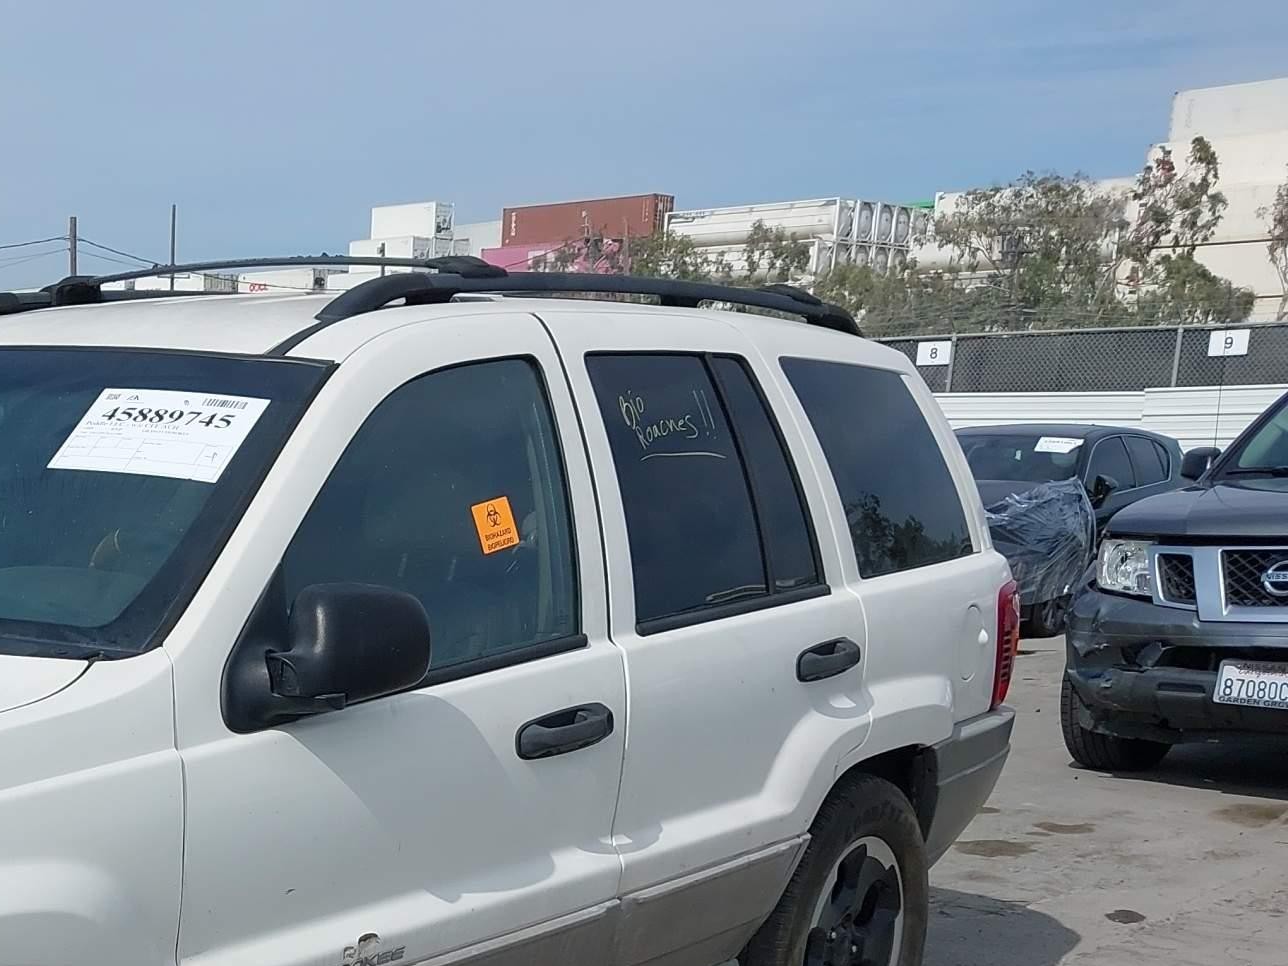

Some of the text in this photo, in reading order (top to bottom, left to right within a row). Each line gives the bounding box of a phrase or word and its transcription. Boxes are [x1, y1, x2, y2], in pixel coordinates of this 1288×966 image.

[1223, 336, 1234, 350] 9
[928, 347, 939, 360] 8
[619, 389, 644, 431] Bio
[101, 406, 236, 429] 45889745
[485, 527, 511, 541] BIOHAZARD
[1218, 695, 1259, 706] GARDEN
